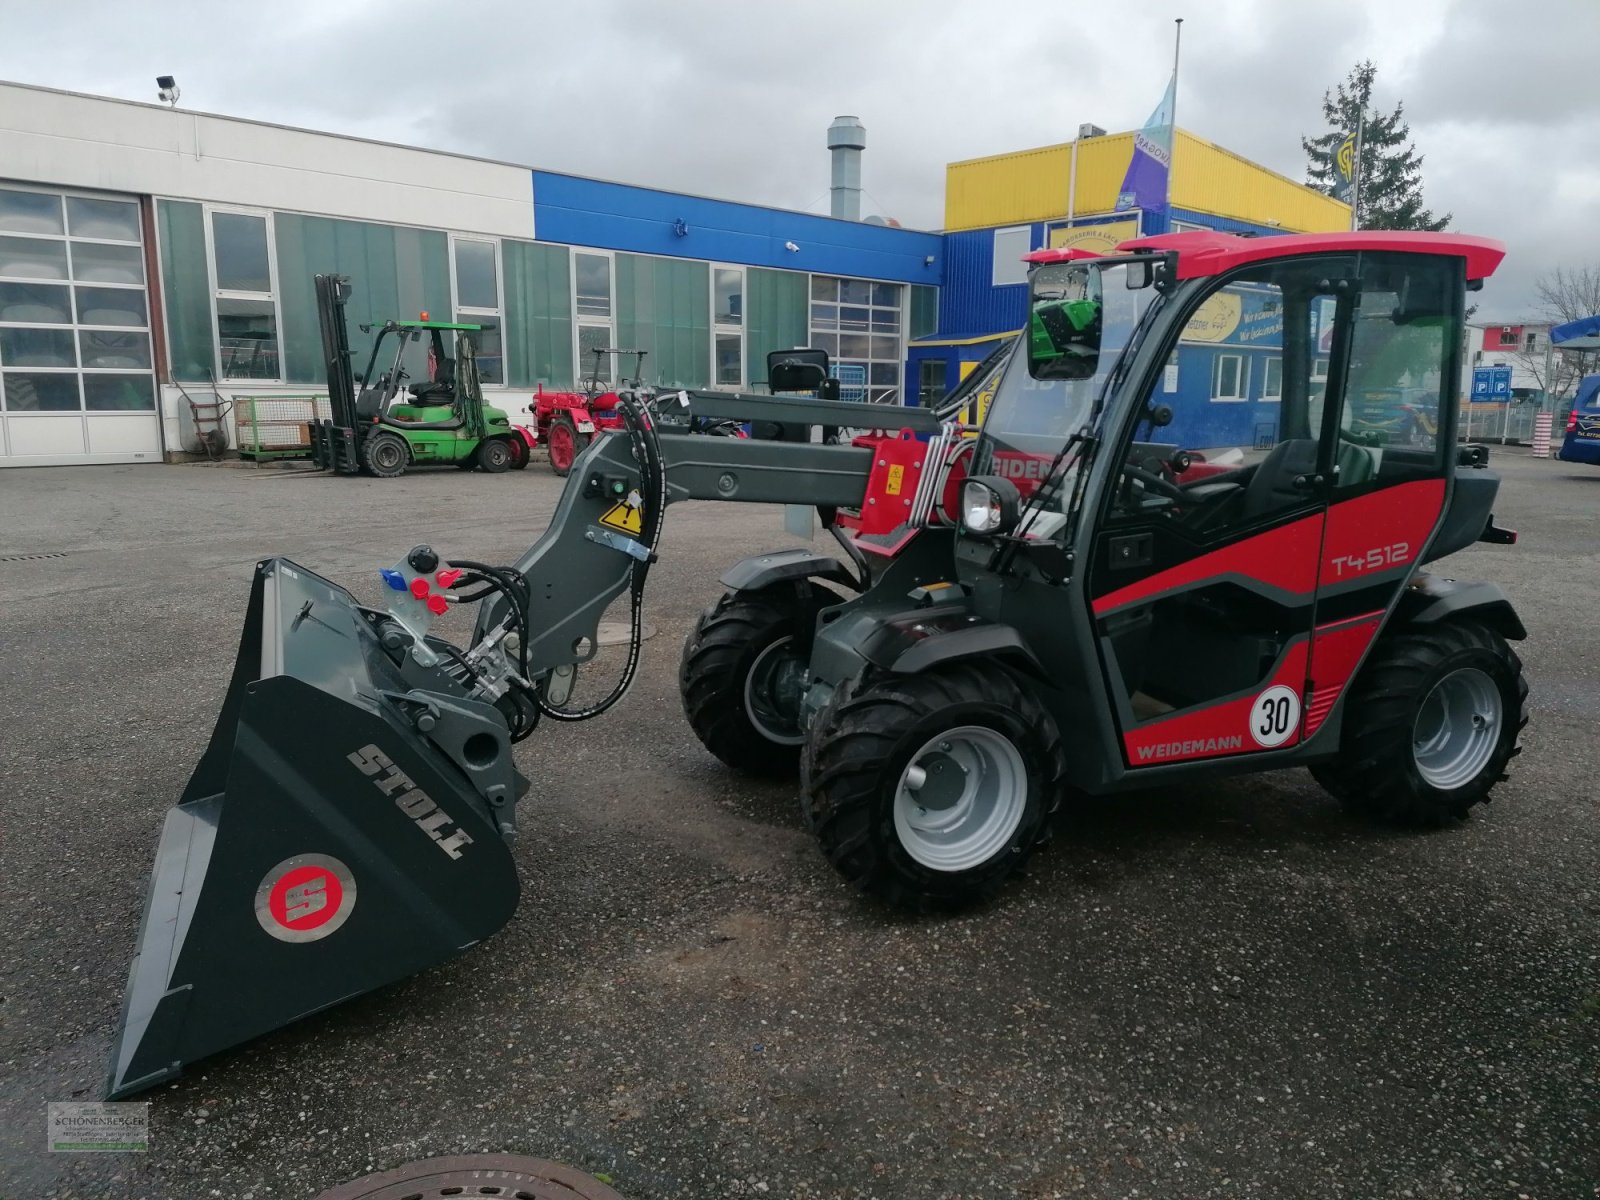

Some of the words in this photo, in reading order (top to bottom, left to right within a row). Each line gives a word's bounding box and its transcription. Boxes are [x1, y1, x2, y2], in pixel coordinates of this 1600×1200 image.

[1059, 230, 1097, 248] AROSSERIE
[1478, 383, 1486, 392] P
[1497, 383, 1505, 392] P
[1331, 542, 1409, 576] T4512
[1260, 696, 1290, 736] 30
[1137, 735, 1242, 760] WEIDEMANN
[346, 743, 475, 861] STOLL
[285, 874, 328, 924] S
